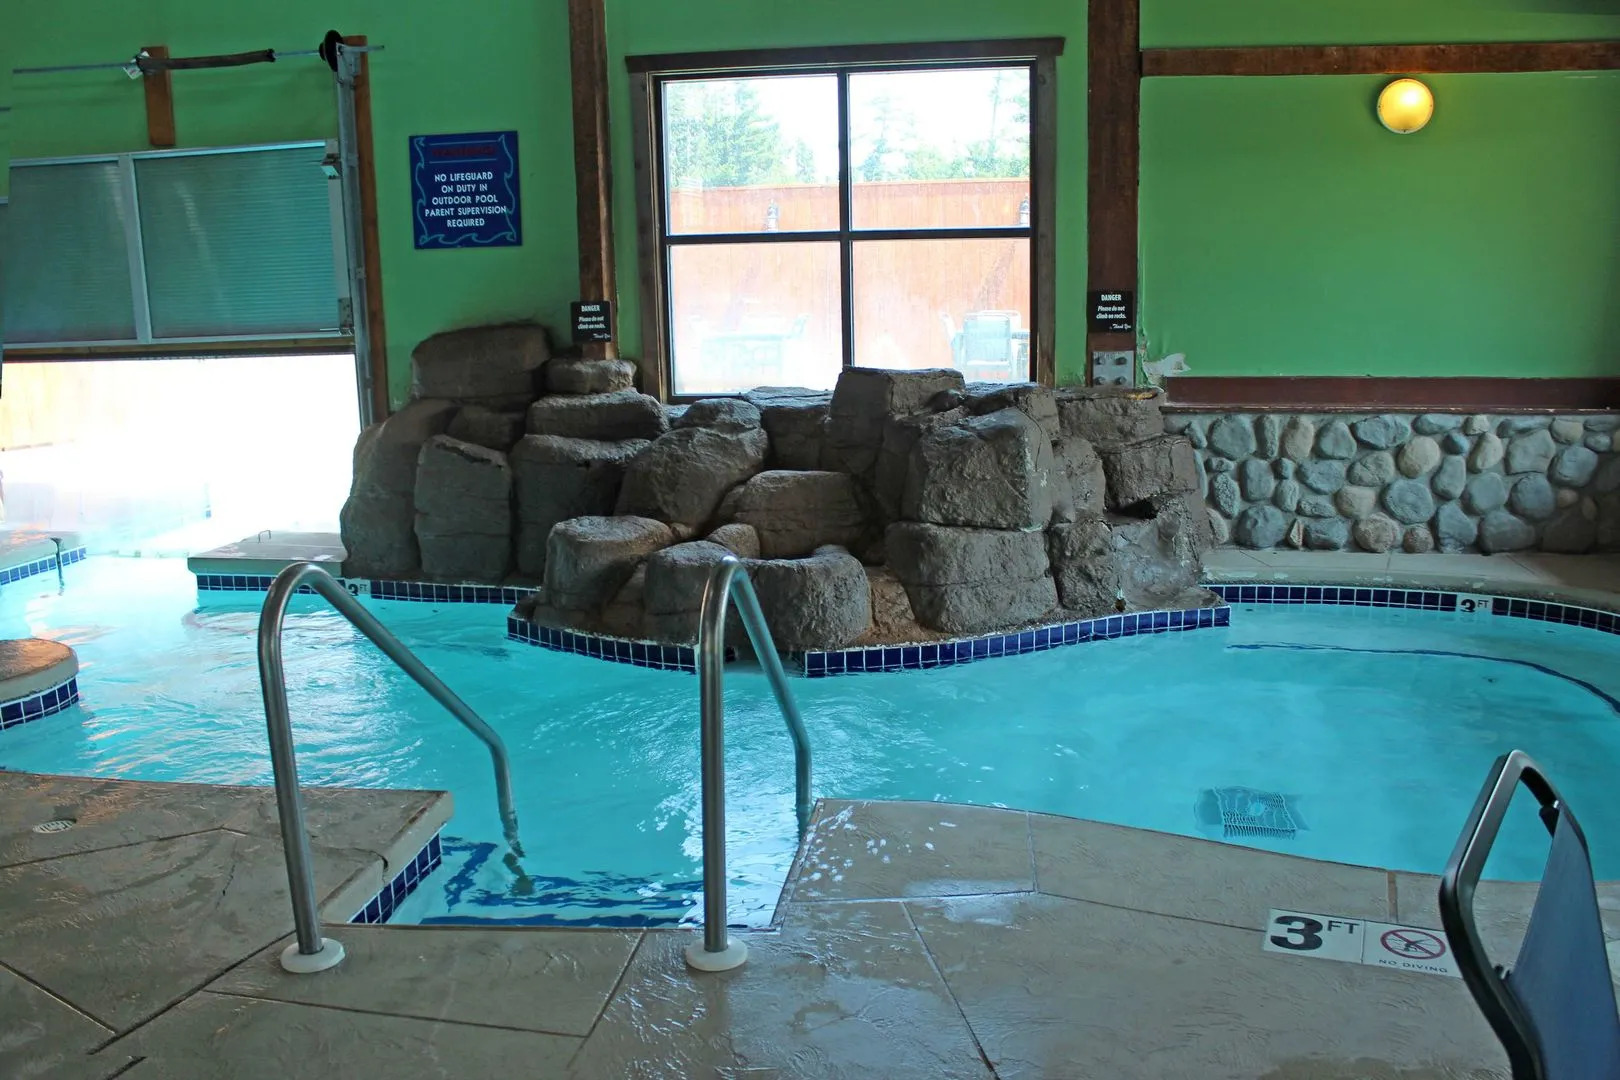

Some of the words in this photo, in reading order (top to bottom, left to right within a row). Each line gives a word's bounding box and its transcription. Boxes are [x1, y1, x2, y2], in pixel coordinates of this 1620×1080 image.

[434, 174, 447, 182] NO
[450, 172, 493, 182] LIFEGUARD
[442, 185, 454, 193] ON
[456, 184, 476, 192] DUTY
[480, 184, 488, 192] IN
[432, 196, 472, 205] OUTDOOR
[476, 194, 498, 203] POOL
[425, 208, 454, 217] PARENT
[458, 206, 507, 216] SUPERVISION
[447, 218, 485, 228] REQUIRED
[348, 584, 358, 596] 3
[1460, 598, 1476, 613] 3
[1478, 600, 1488, 608] FT
[1270, 916, 1323, 951] 3
[1327, 920, 1360, 934] FT
[1402, 962, 1448, 974] DIVING
